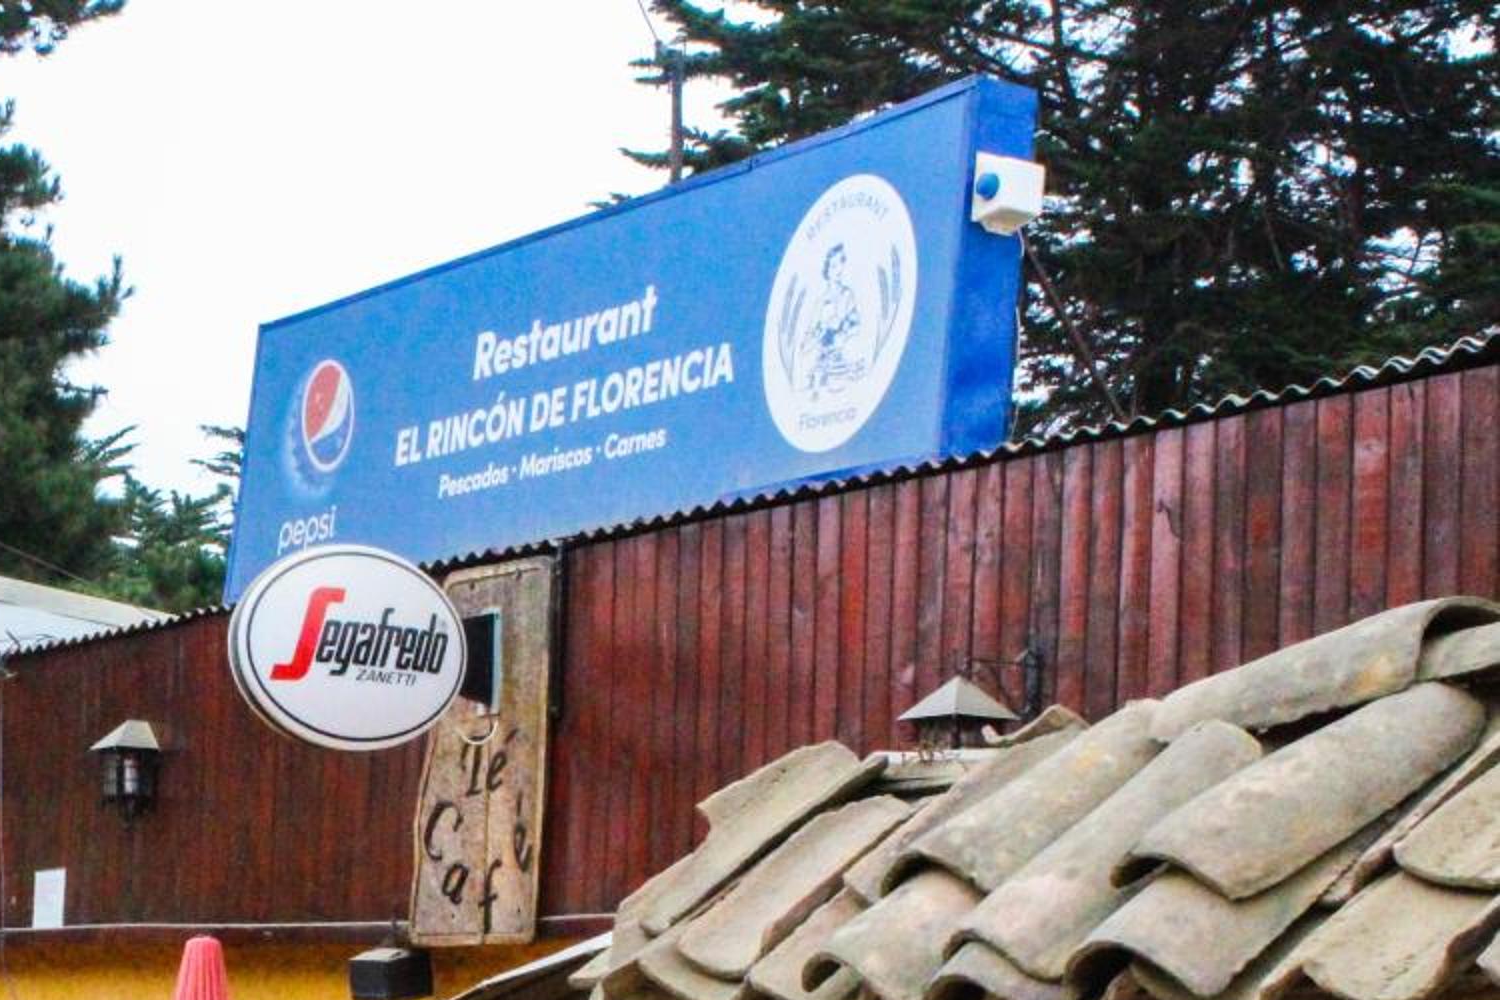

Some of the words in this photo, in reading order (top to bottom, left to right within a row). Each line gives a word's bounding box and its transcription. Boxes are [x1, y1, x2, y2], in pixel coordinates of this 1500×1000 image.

[472, 284, 657, 381] Restaurant
[395, 429, 421, 466] EL
[426, 391, 526, 458] RINCÓN
[530, 387, 567, 433] DE
[570, 343, 735, 423] FLORENCIA
[437, 464, 509, 499] Pescados
[519, 447, 593, 480] Mariscos
[603, 428, 667, 459] Carnes
[277, 505, 337, 556] pepsi
[269, 586, 449, 681] Segafredo
[355, 668, 417, 687] ZANETTI
